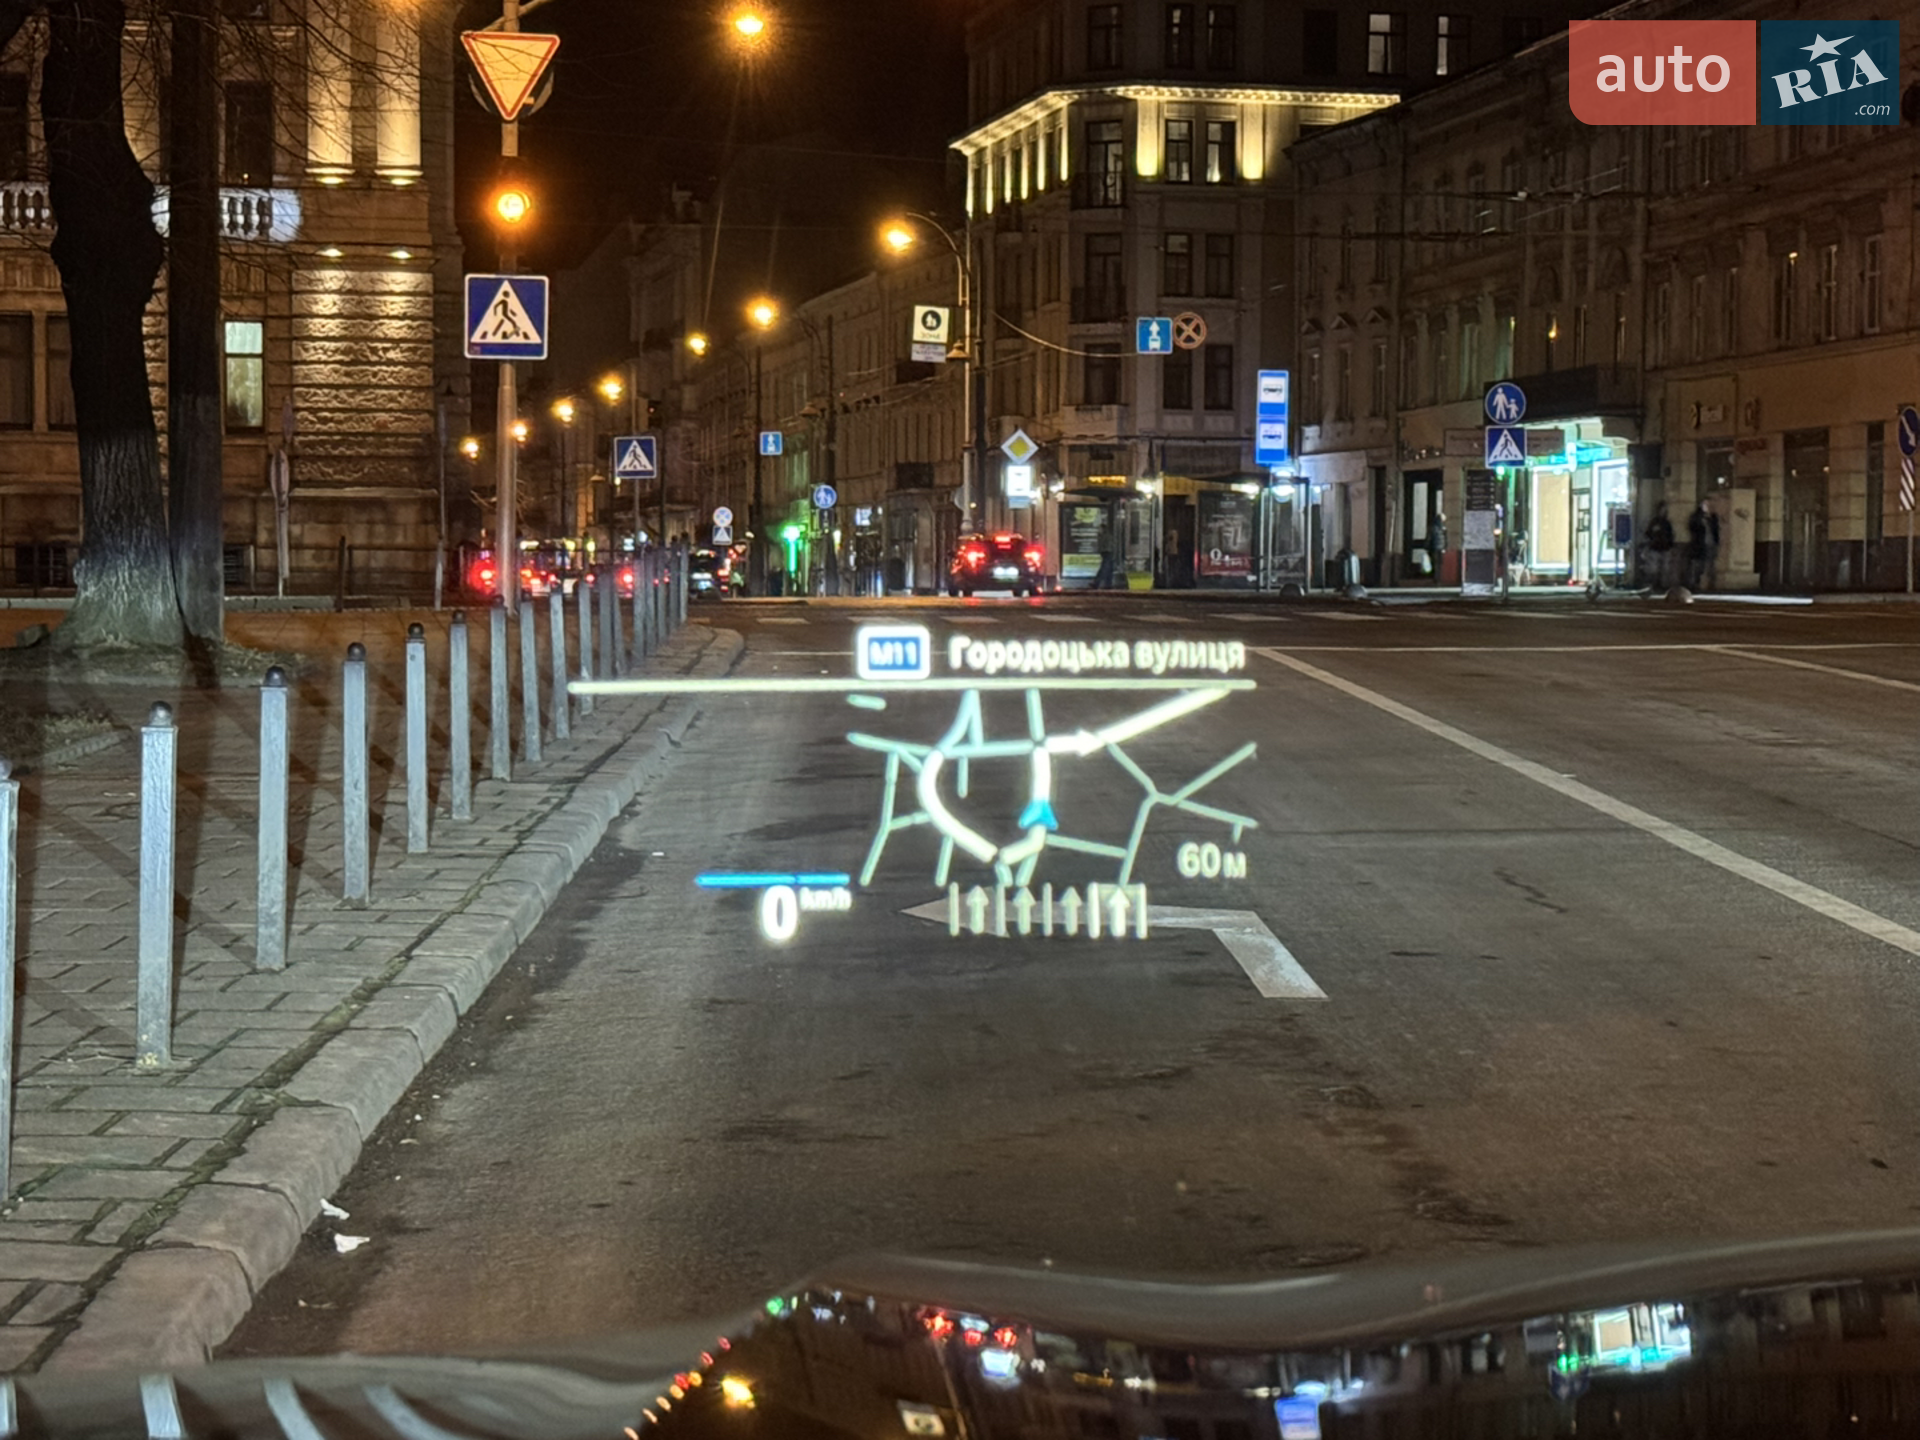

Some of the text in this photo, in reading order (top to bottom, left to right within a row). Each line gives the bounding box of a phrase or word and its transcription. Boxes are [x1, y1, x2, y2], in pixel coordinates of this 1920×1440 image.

[949, 635, 1130, 675] Городоцька
[1134, 640, 1245, 675] вулиця
[762, 884, 798, 941] 0
